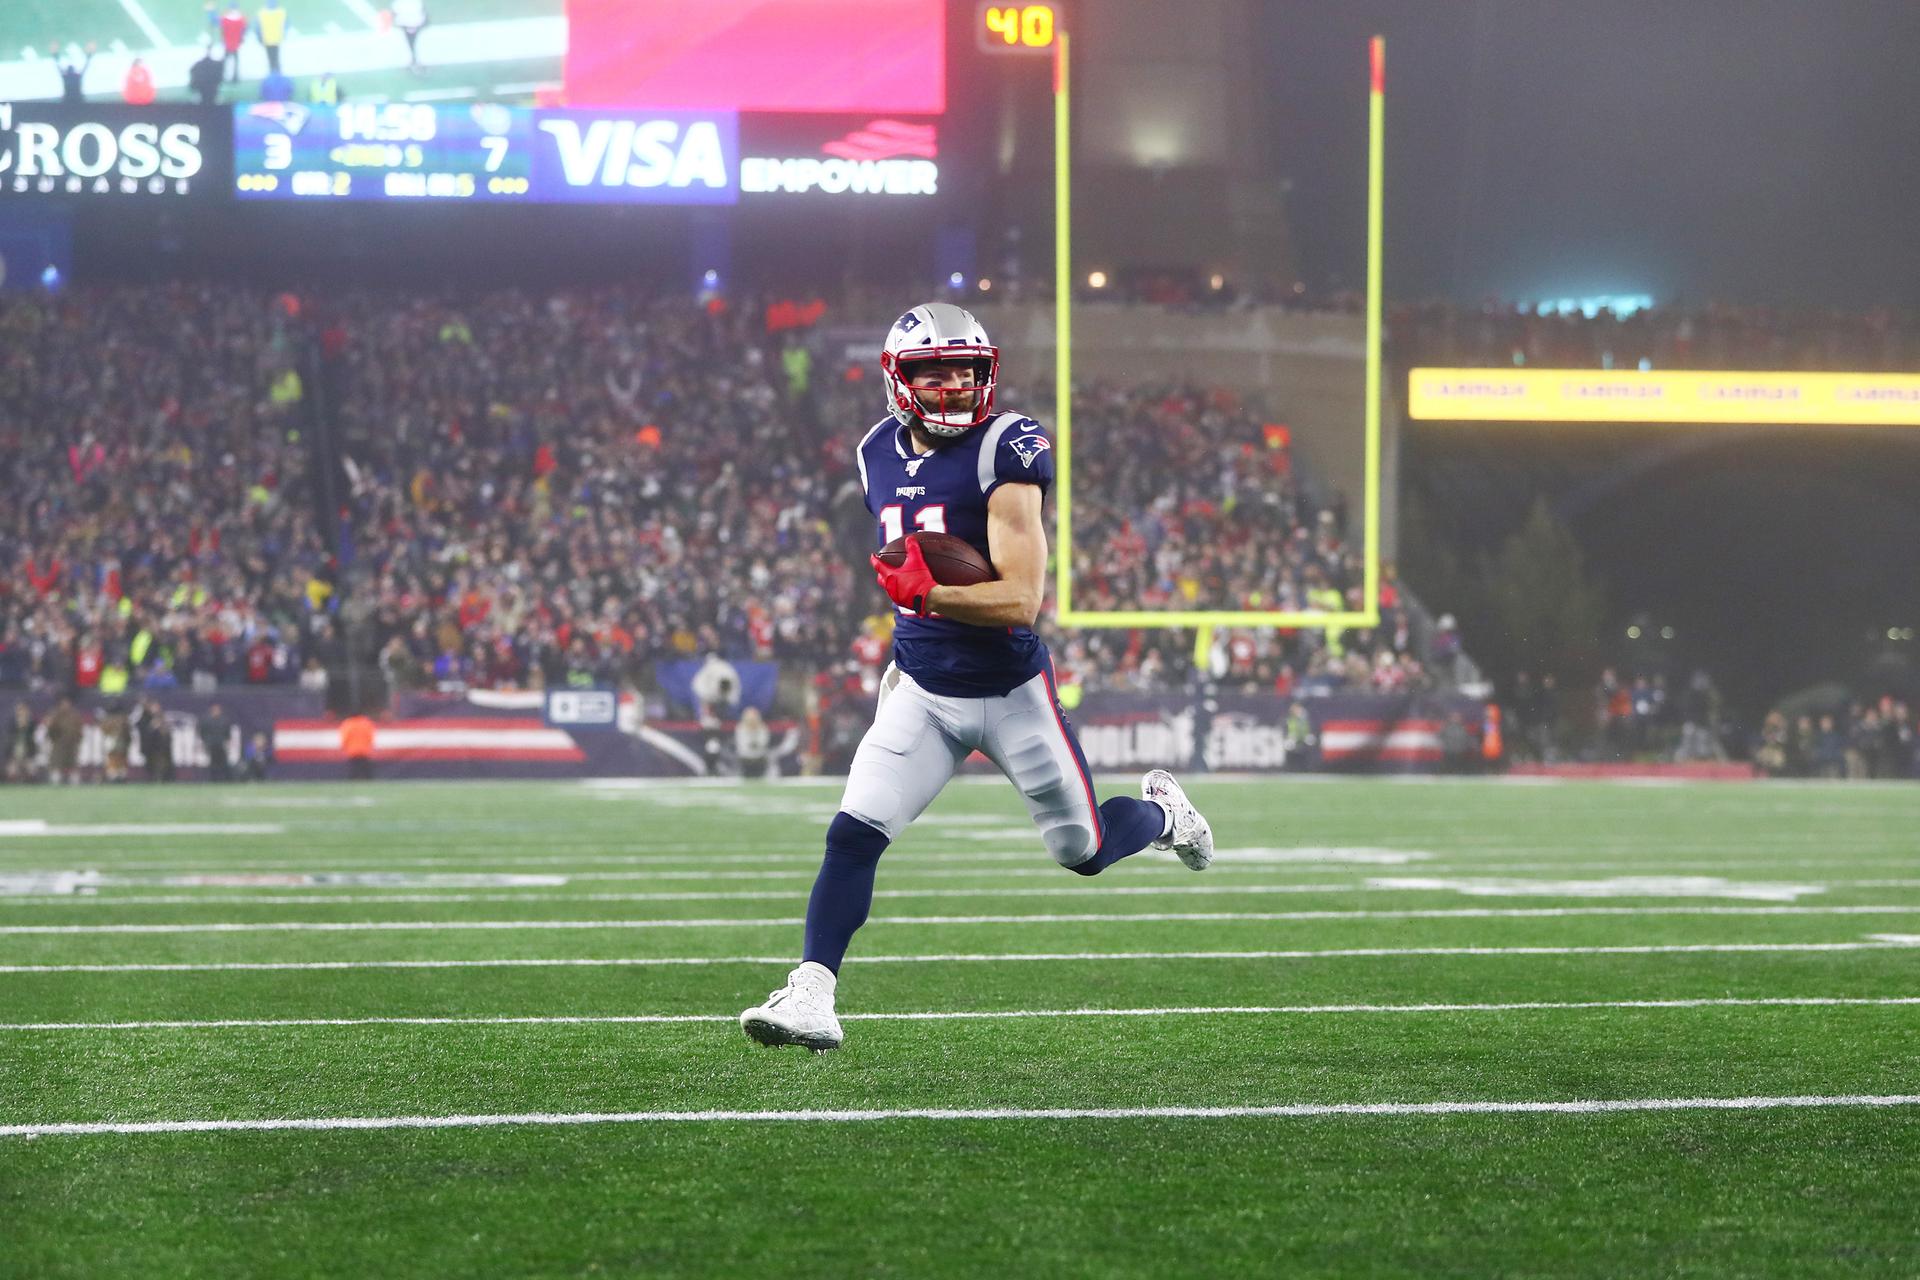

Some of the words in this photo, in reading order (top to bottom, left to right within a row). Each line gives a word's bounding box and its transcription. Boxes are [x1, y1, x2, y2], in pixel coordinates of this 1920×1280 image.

[986, 5, 1053, 47] 40
[264, 133, 292, 169] 3
[480, 136, 509, 171] 7
[538, 119, 728, 188] VISA
[740, 157, 938, 195] EMPOWER
